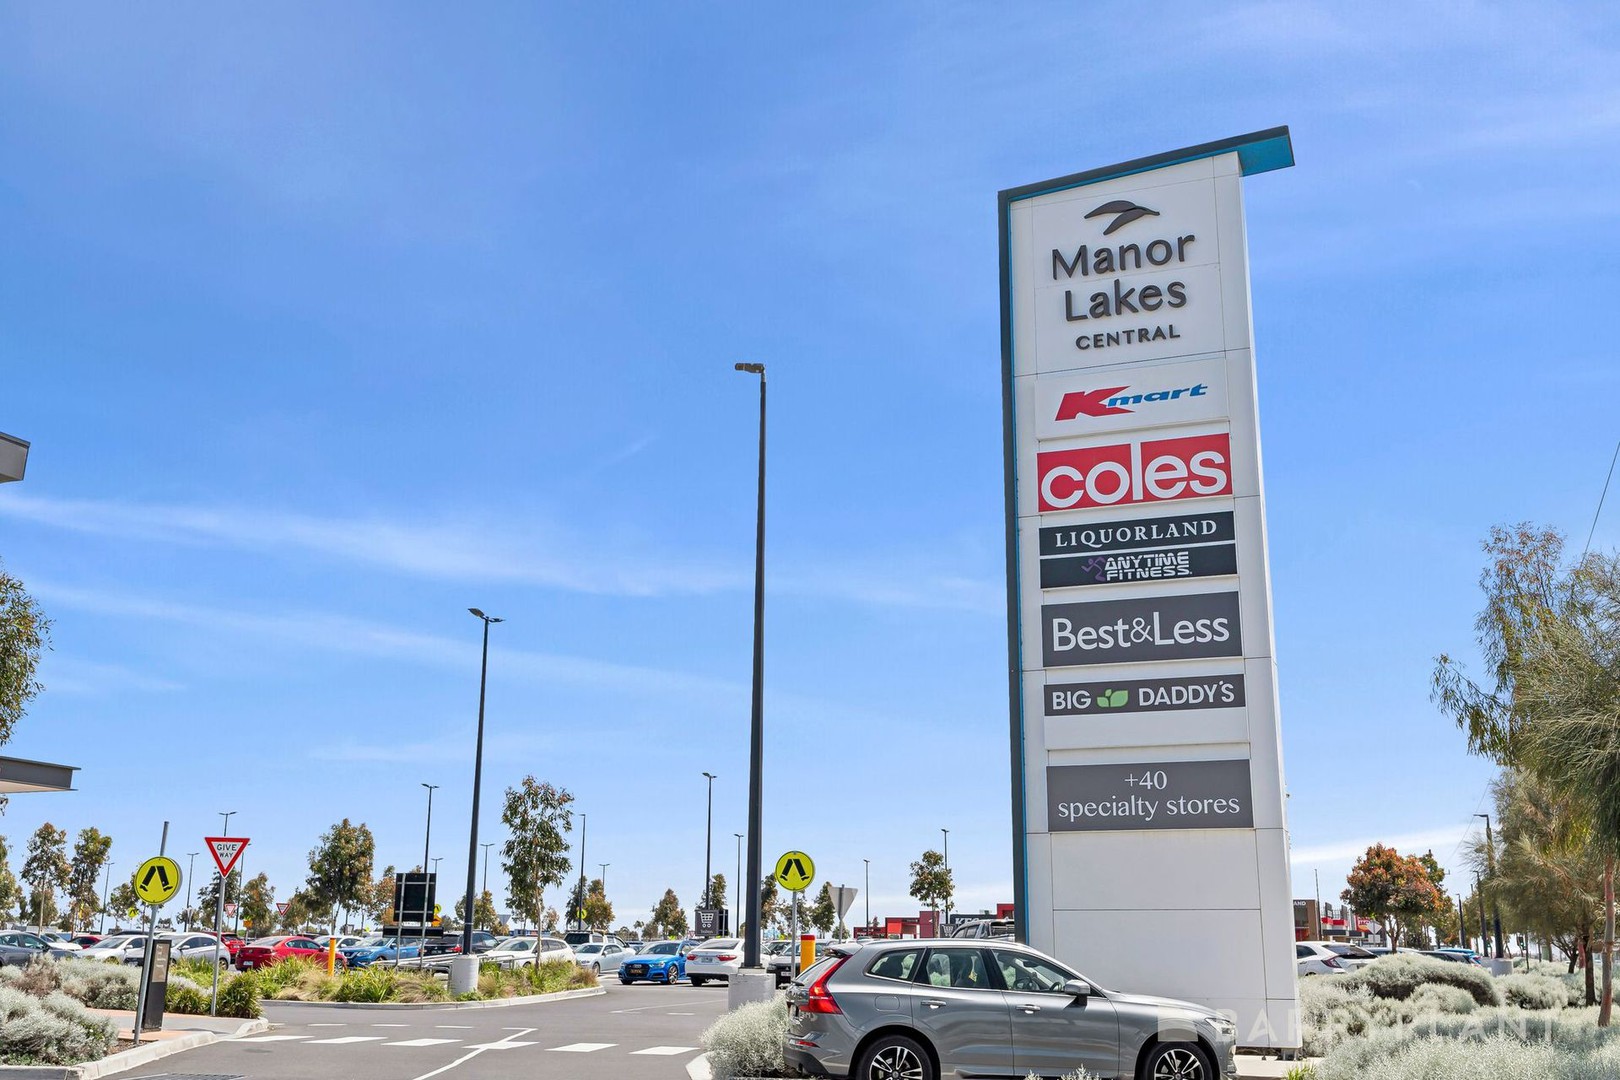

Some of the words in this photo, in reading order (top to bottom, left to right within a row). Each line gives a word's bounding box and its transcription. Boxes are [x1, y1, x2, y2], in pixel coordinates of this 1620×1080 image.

[1052, 235, 1195, 280] Manor
[1065, 278, 1187, 322] Lakes
[1076, 324, 1180, 350] CENTRAL
[1055, 383, 1208, 421] Kmart
[1041, 443, 1228, 508] coles
[1055, 520, 1217, 548] LIQUORLAND
[1105, 551, 1189, 570] ANYTIME
[1052, 690, 1092, 710] BIG
[1139, 680, 1235, 706] DADDY'S
[1124, 771, 1168, 790] +40
[1058, 795, 1159, 822] specialty
[1166, 796, 1241, 815] stores
[216, 843, 238, 851] GIVE
